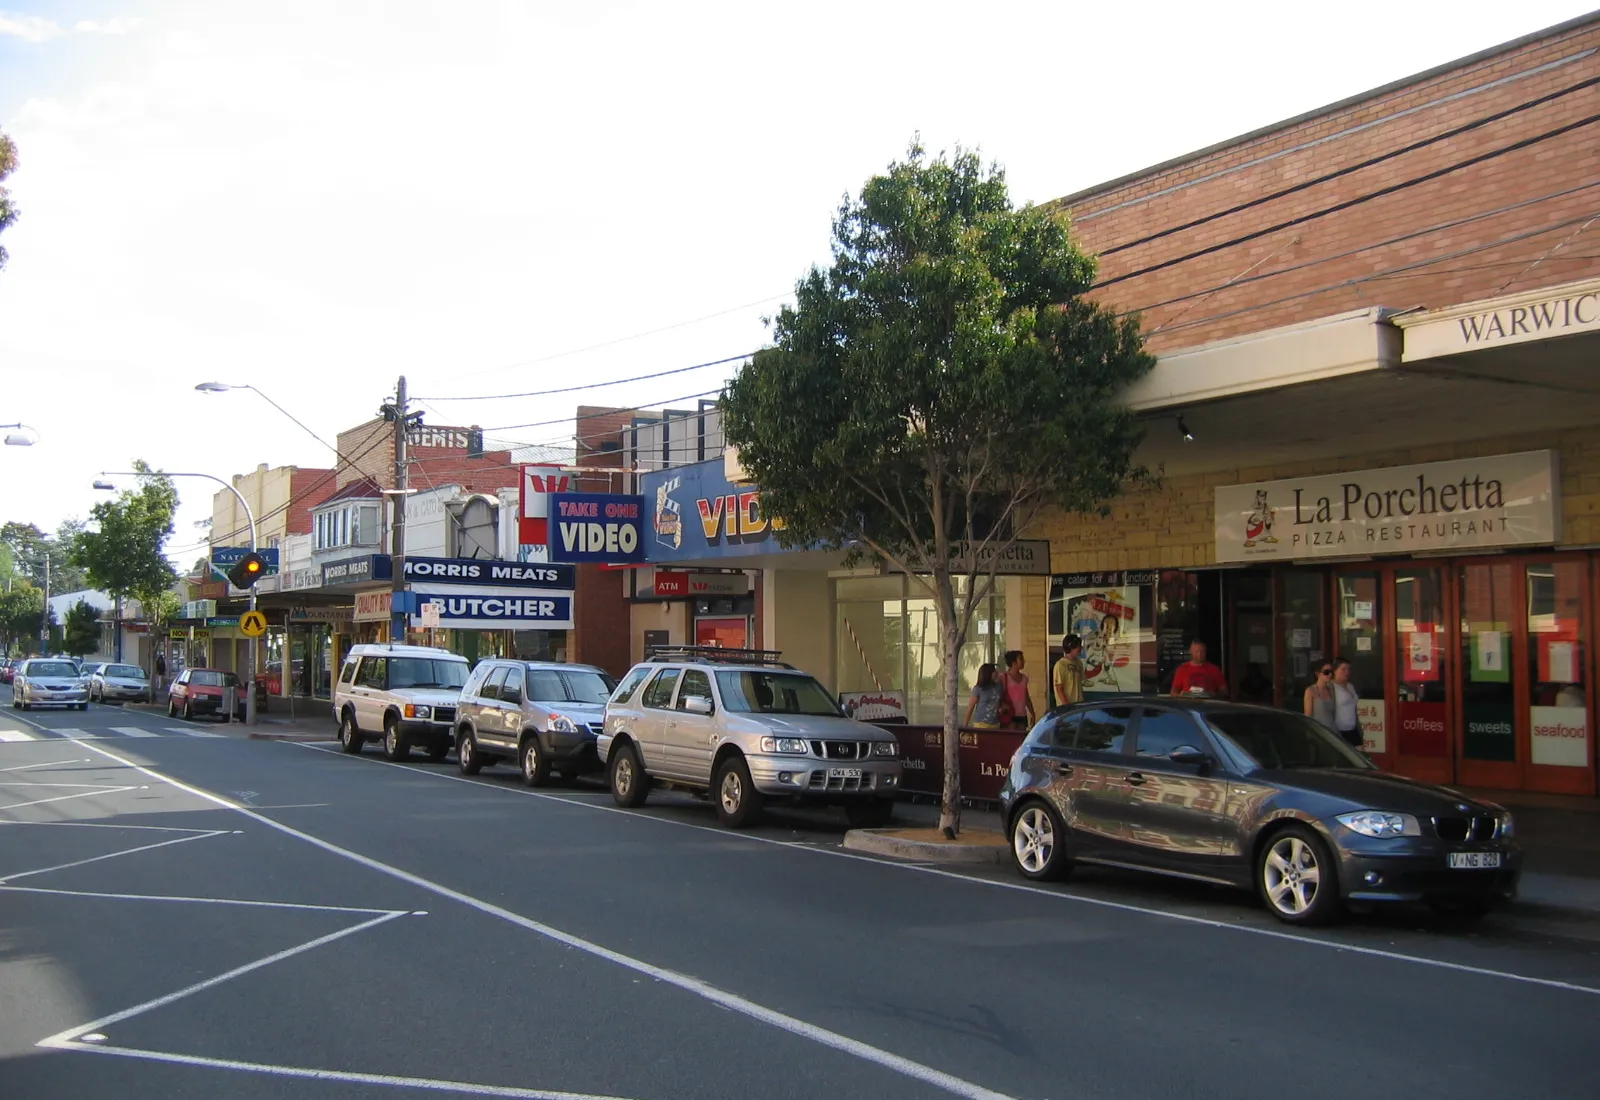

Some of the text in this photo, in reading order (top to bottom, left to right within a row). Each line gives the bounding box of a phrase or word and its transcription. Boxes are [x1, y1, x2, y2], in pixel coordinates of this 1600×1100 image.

[1293, 474, 1505, 525] La Porchetta
[559, 502, 638, 518] TAKE ONE
[697, 490, 787, 538] VID
[559, 522, 638, 553] VIDEO
[1293, 518, 1509, 547] PIZZA RESTAURANT
[325, 561, 368, 578] MORRIS MEATS
[404, 562, 558, 581] MORRIS MEATS
[1052, 577, 1064, 585] we
[1068, 575, 1088, 584] cater
[1092, 573, 1104, 583] for
[1108, 573, 1117, 582] all
[430, 598, 555, 616] BUTCHER
[1403, 718, 1444, 731] coffees
[1469, 721, 1511, 734] sweets
[1534, 722, 1585, 738] seafood
[899, 755, 926, 770] rchetta
